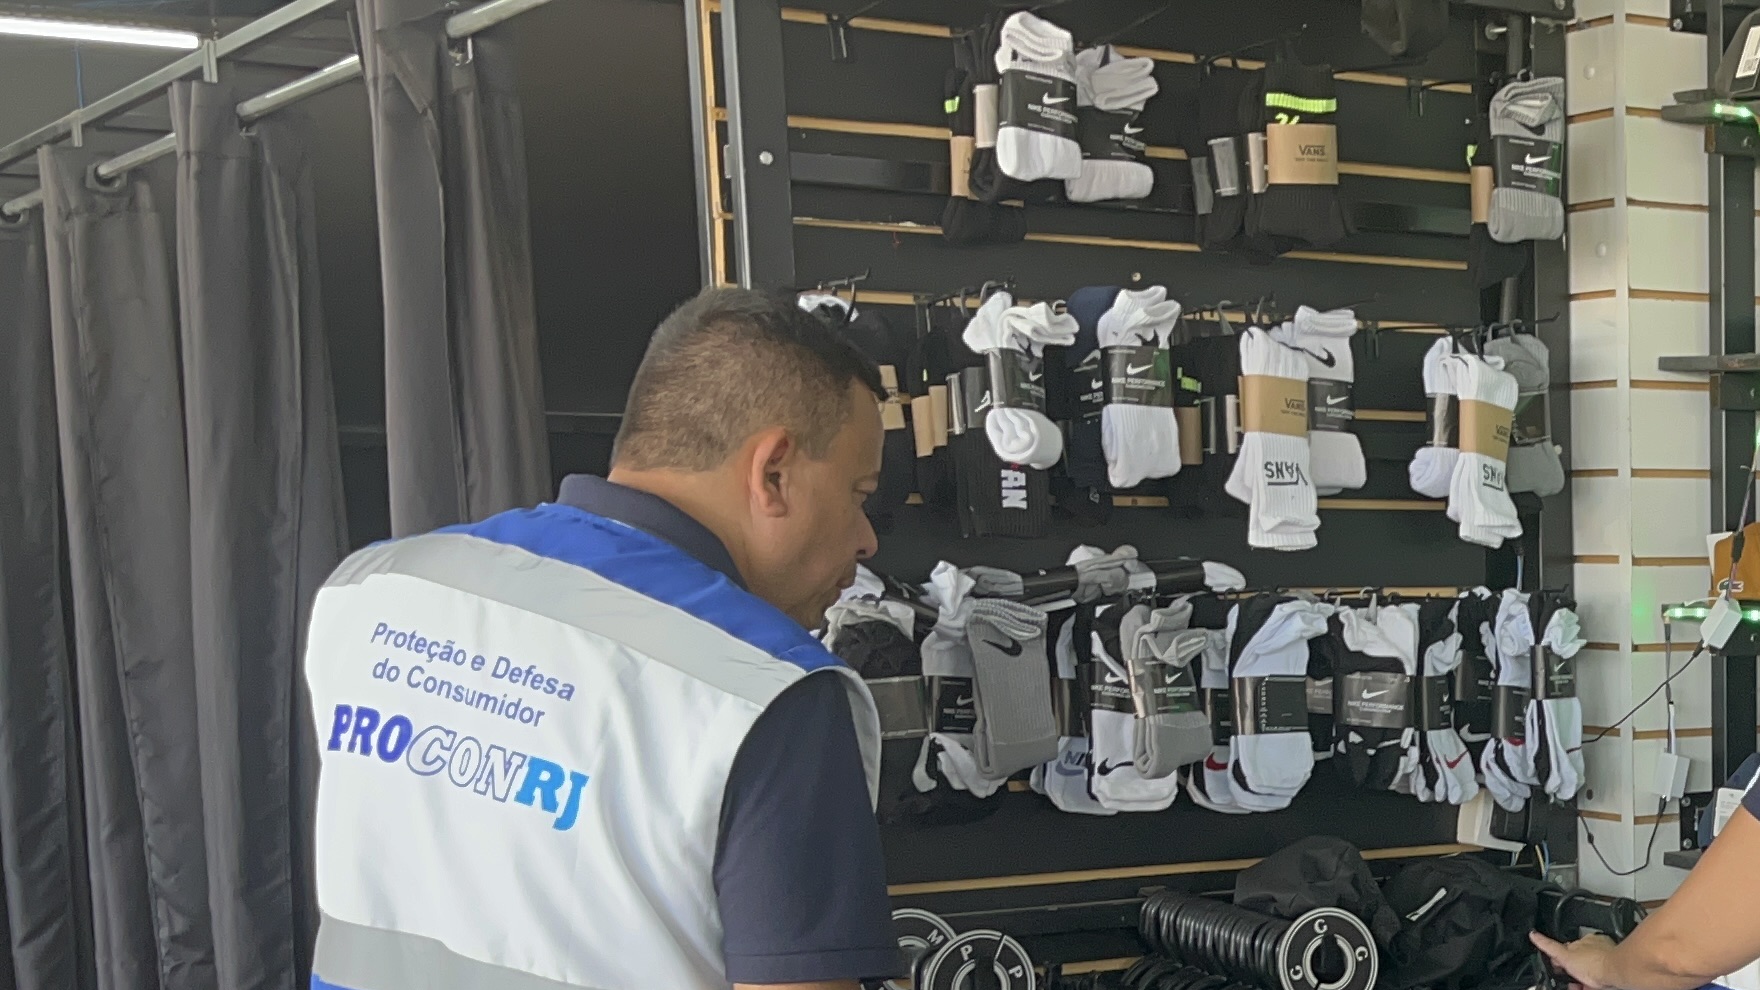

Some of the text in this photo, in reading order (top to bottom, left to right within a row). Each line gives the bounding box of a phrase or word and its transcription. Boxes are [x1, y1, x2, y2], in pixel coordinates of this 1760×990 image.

[1299, 144, 1326, 156] VANS
[1264, 461, 1308, 486] VANS
[370, 622, 576, 702] Proteção e Defesa
[372, 657, 545, 727] do Consumidor
